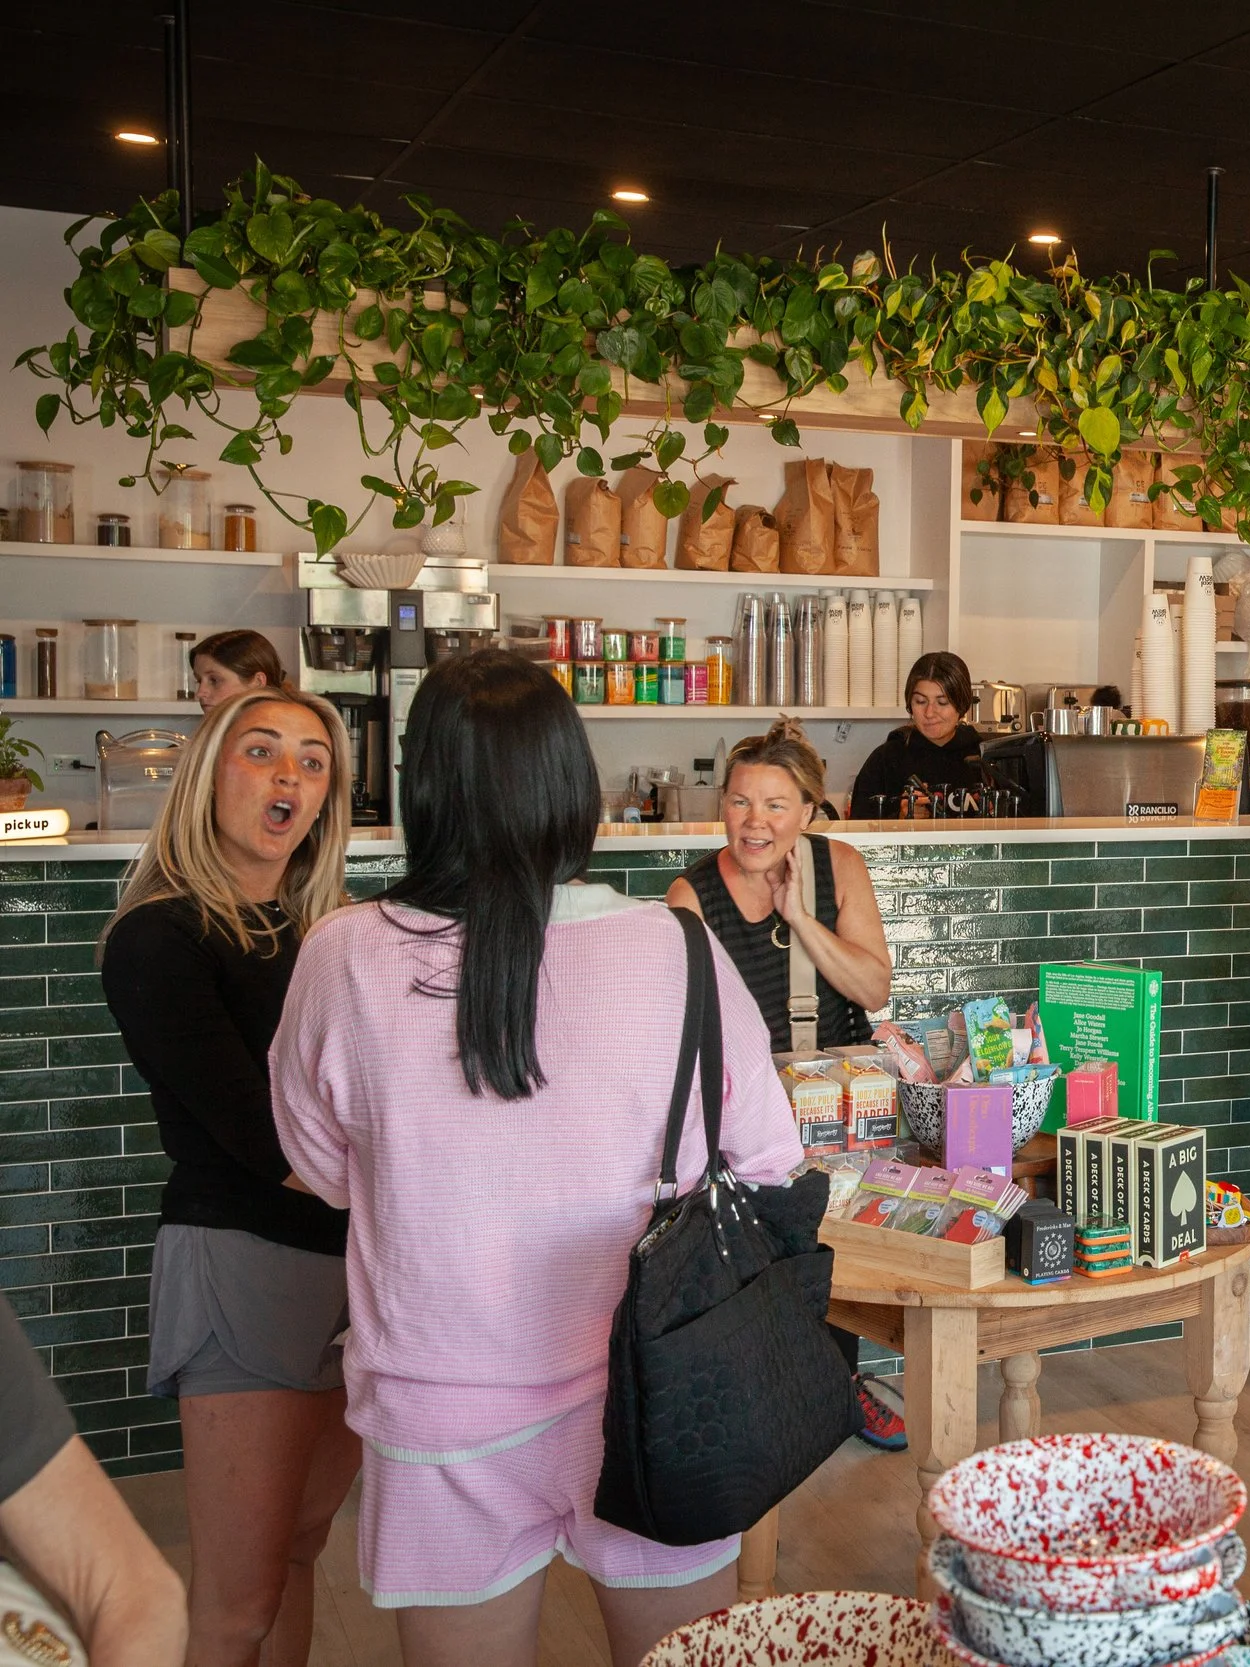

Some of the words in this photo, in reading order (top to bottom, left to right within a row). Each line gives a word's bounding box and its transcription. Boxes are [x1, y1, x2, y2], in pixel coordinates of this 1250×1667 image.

[1140, 806, 1176, 814] RANCILIO
[1086, 1013, 1105, 1021] Goodall
[985, 1034, 1000, 1043] SOUR
[1070, 1032, 1088, 1040] Martha
[1097, 1049, 1119, 1057] Williams
[1149, 1049, 1156, 1057] to
[1146, 1058, 1155, 1100] Becoming
[857, 1088, 873, 1100] 100%
[874, 1087, 889, 1098] PULP
[856, 1100, 879, 1109] BECAUSE
[880, 1099, 889, 1107] IT'S
[1116, 1156, 1124, 1164] A
[1169, 1153, 1177, 1169] A
[1179, 1146, 1197, 1165] BIG
[1143, 1160, 1150, 1168] A
[1117, 1191, 1124, 1207] OF
[1143, 1194, 1150, 1210] OF
[1171, 1229, 1197, 1251] DEAL
